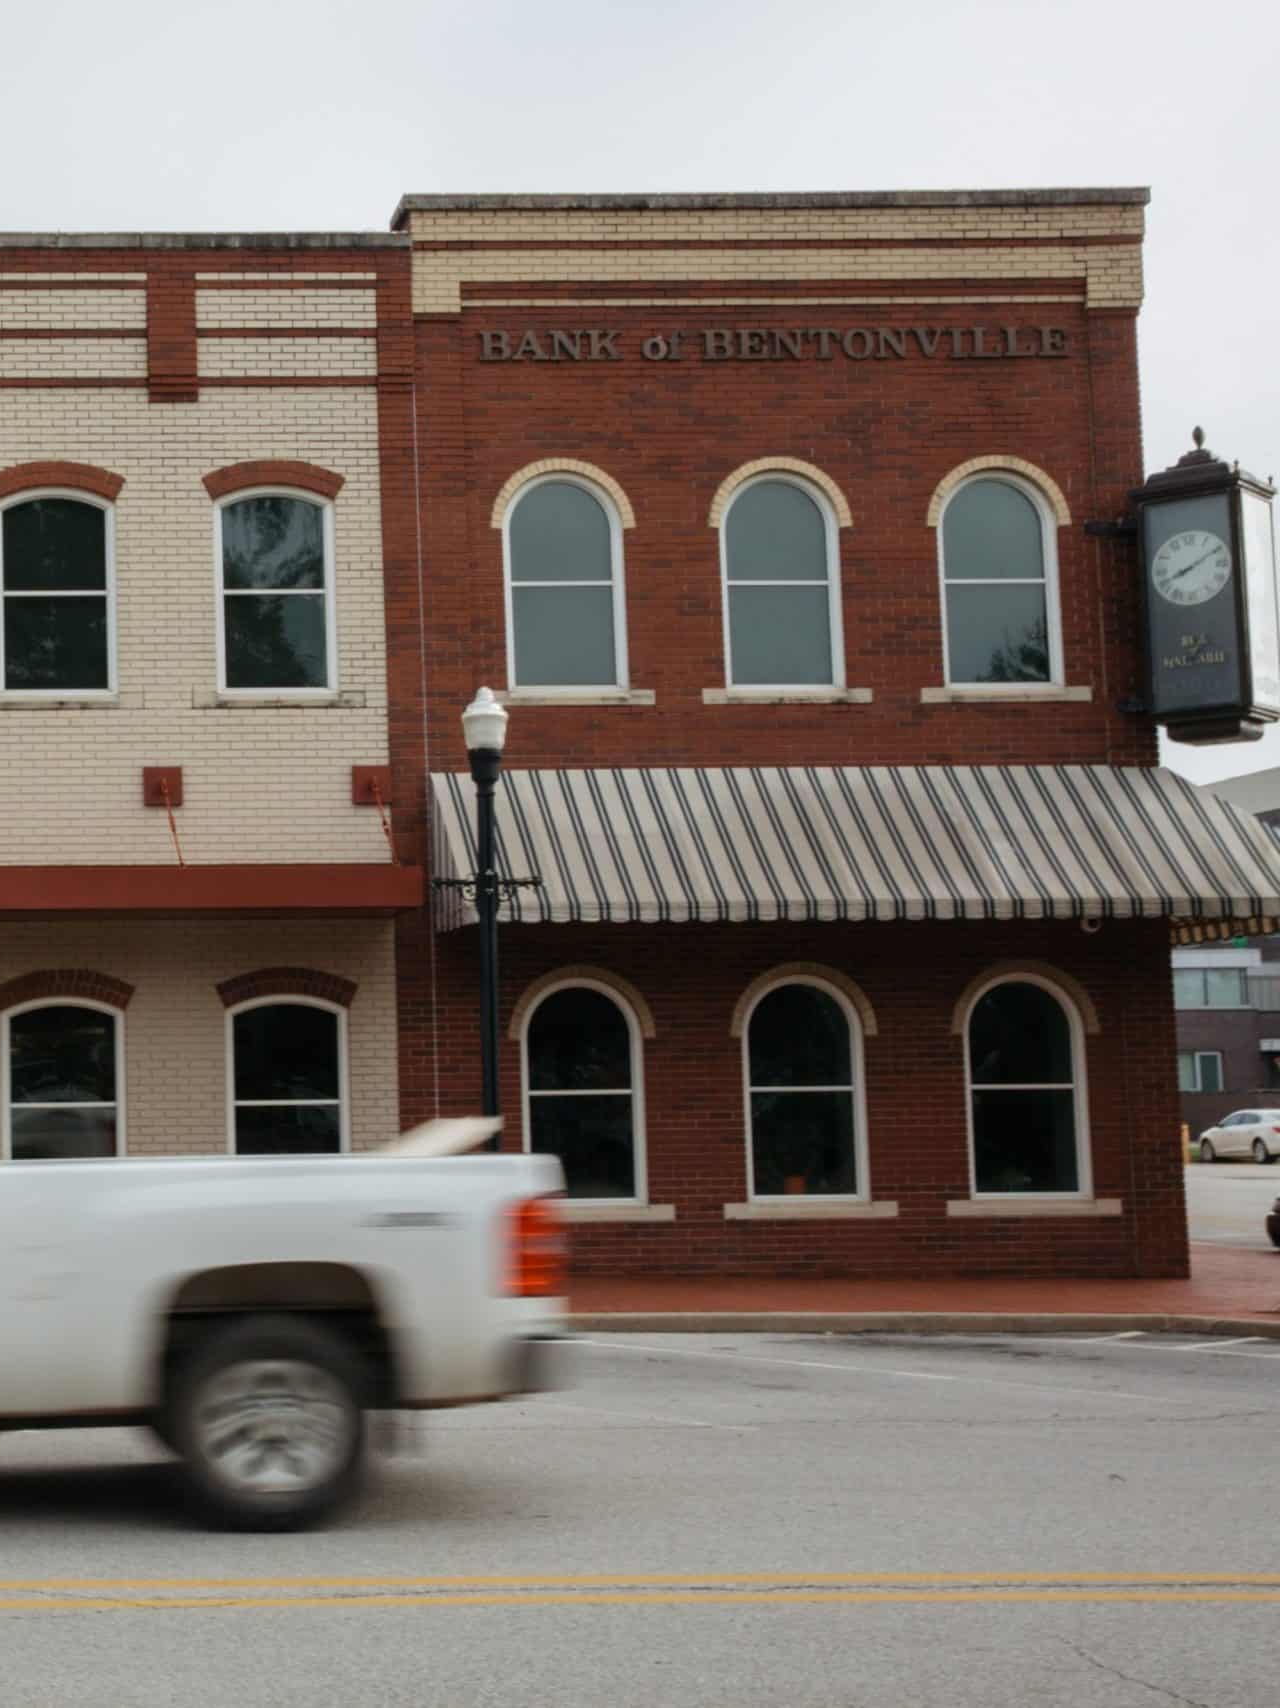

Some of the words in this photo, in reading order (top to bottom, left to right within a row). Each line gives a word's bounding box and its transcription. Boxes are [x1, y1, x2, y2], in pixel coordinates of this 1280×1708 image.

[479, 329, 624, 361] BANK
[641, 329, 690, 361] of
[703, 327, 1068, 361] BENTONVILLE
